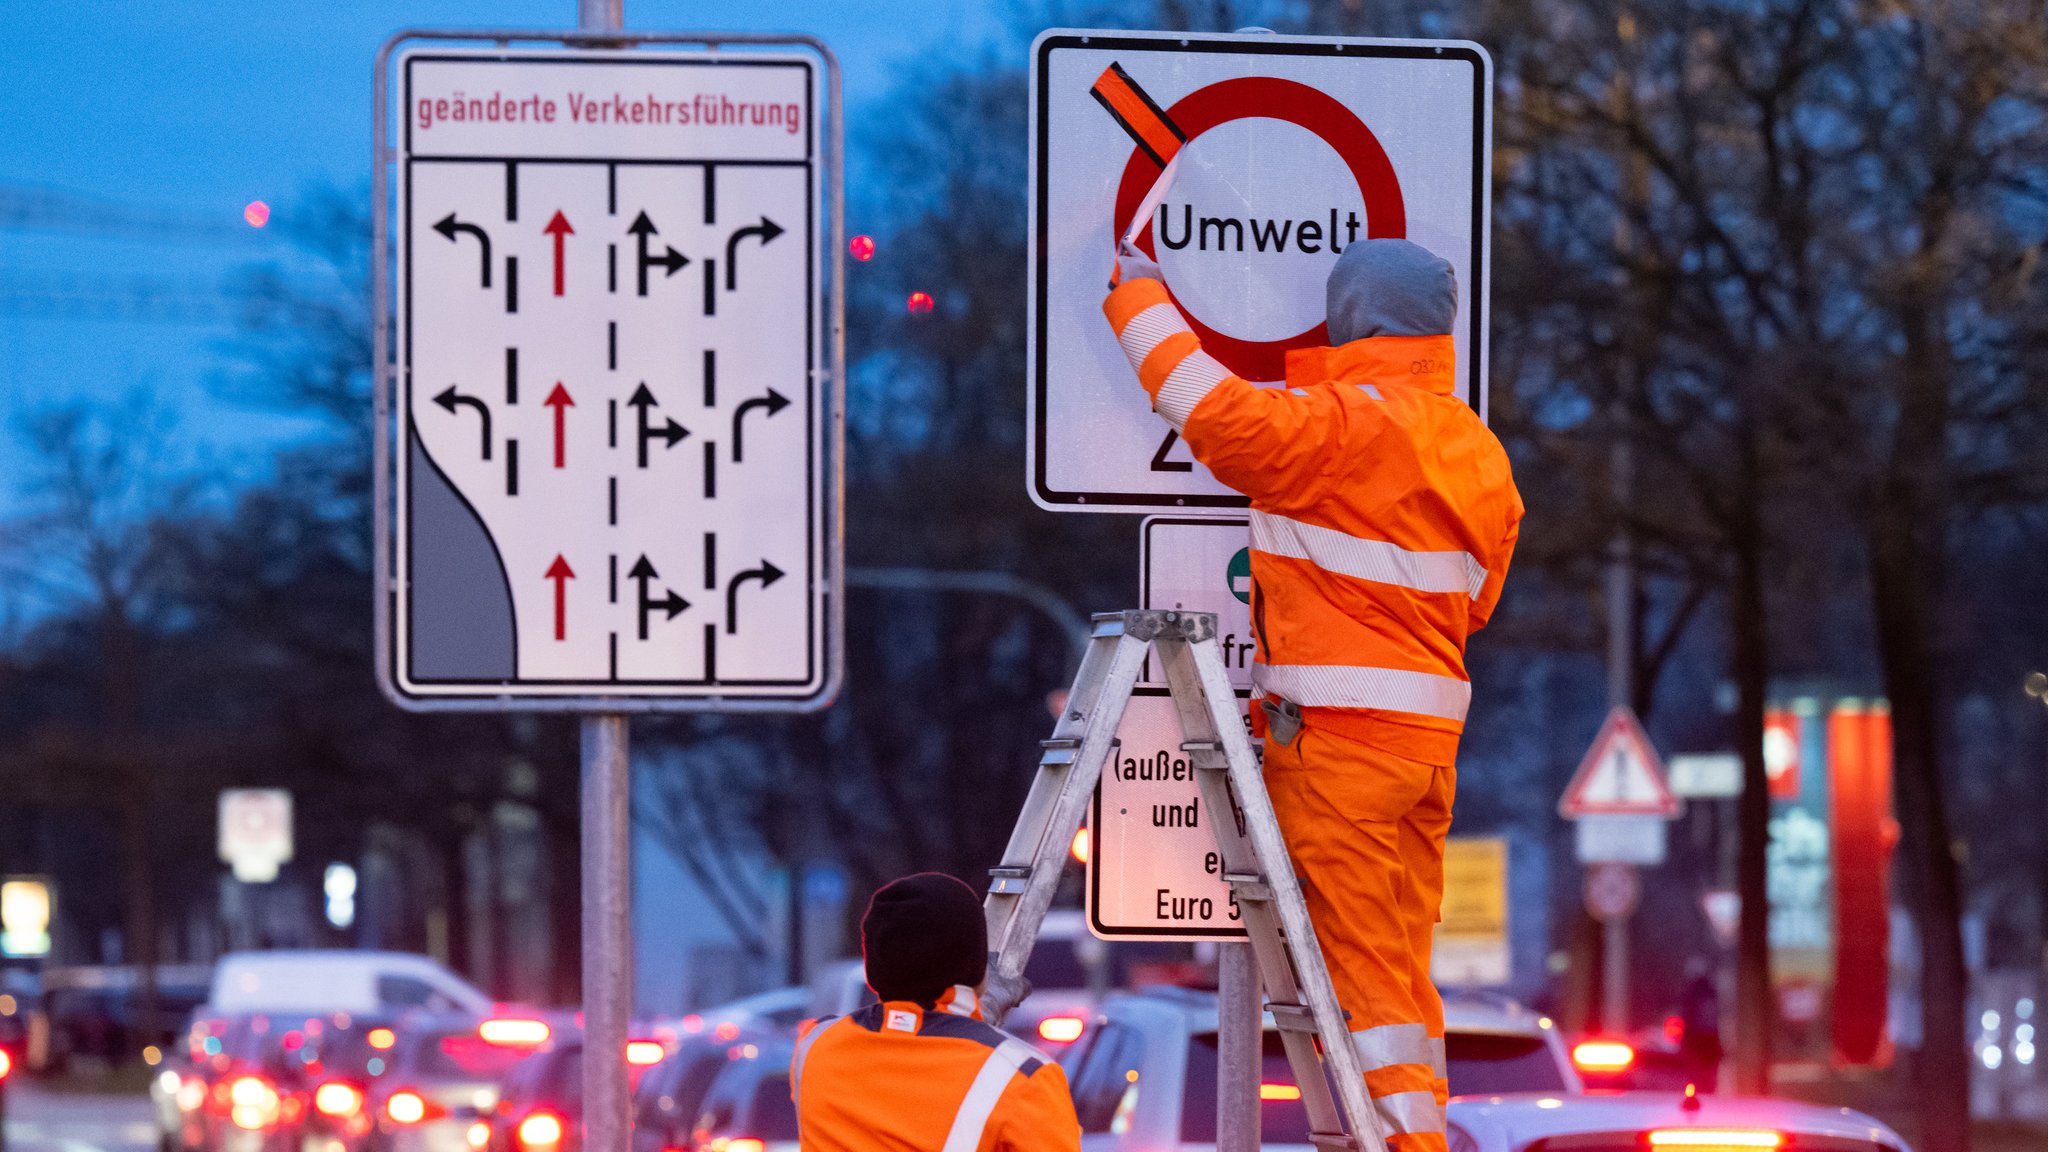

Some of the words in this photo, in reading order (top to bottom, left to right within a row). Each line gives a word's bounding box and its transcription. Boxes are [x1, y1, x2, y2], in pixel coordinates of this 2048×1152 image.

[417, 91, 557, 130] geänderte
[567, 92, 801, 134] Verkehrsführung
[1160, 203, 1361, 255] Umwelt
[1152, 797, 1199, 827] und
[1156, 889, 1213, 920] Euro
